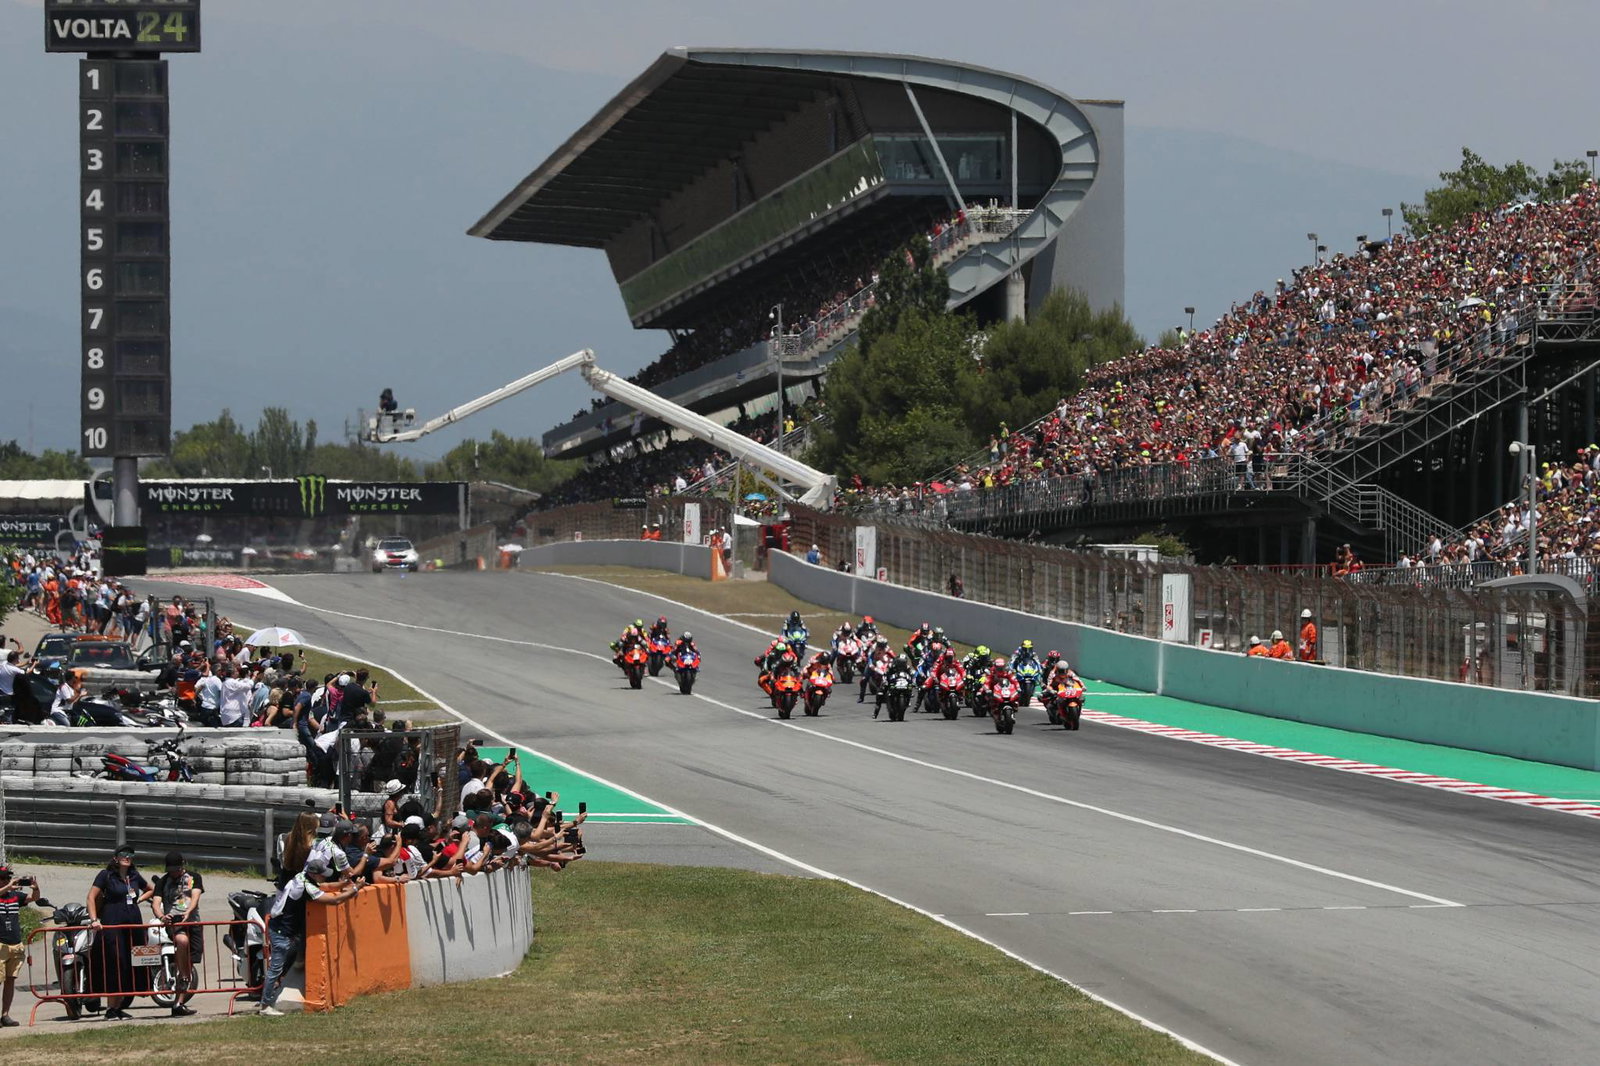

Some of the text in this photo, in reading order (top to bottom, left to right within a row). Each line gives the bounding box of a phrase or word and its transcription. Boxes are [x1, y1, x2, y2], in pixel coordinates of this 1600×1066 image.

[53, 11, 187, 42] VOLTA 24
[86, 69, 100, 90] 1
[86, 110, 103, 130] 2
[87, 150, 103, 170] 3
[86, 189, 104, 211] 4
[87, 229, 103, 250] 5
[86, 269, 103, 290] 6
[87, 308, 103, 329] 7
[87, 348, 104, 369] 8
[87, 388, 105, 410] 9
[84, 428, 107, 449] 10
[148, 485, 234, 502] MONSTER
[337, 486, 422, 502] MONSTER
[0, 520, 51, 532] ONSTER
[1201, 632, 1211, 645] F
